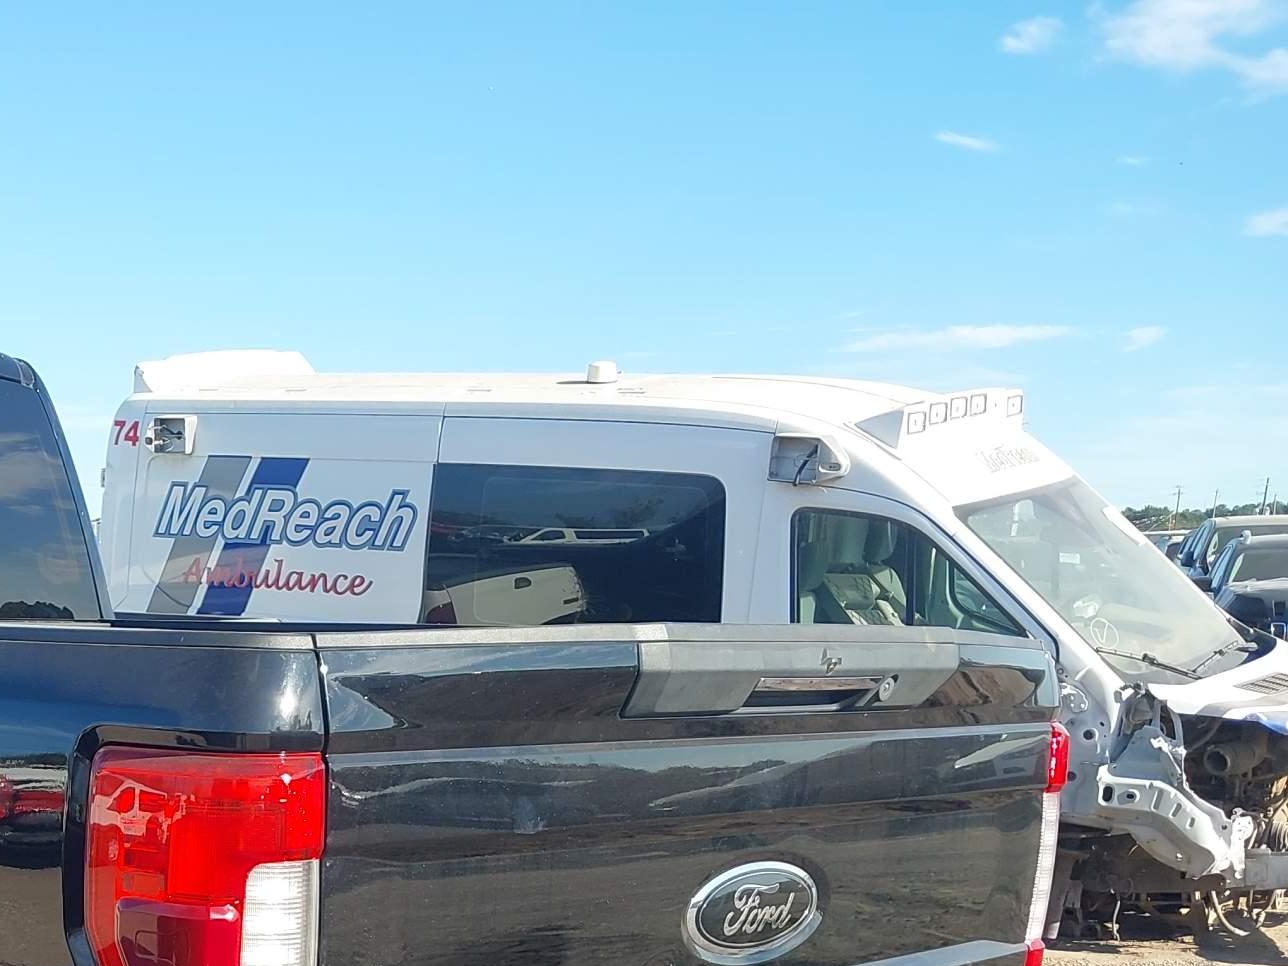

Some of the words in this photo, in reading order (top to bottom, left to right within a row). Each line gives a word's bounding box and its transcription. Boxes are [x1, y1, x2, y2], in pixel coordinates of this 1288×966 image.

[113, 419, 140, 447] 74
[153, 481, 418, 552] MedReach
[183, 557, 373, 597] Ambulance
[723, 882, 795, 936] Ford
